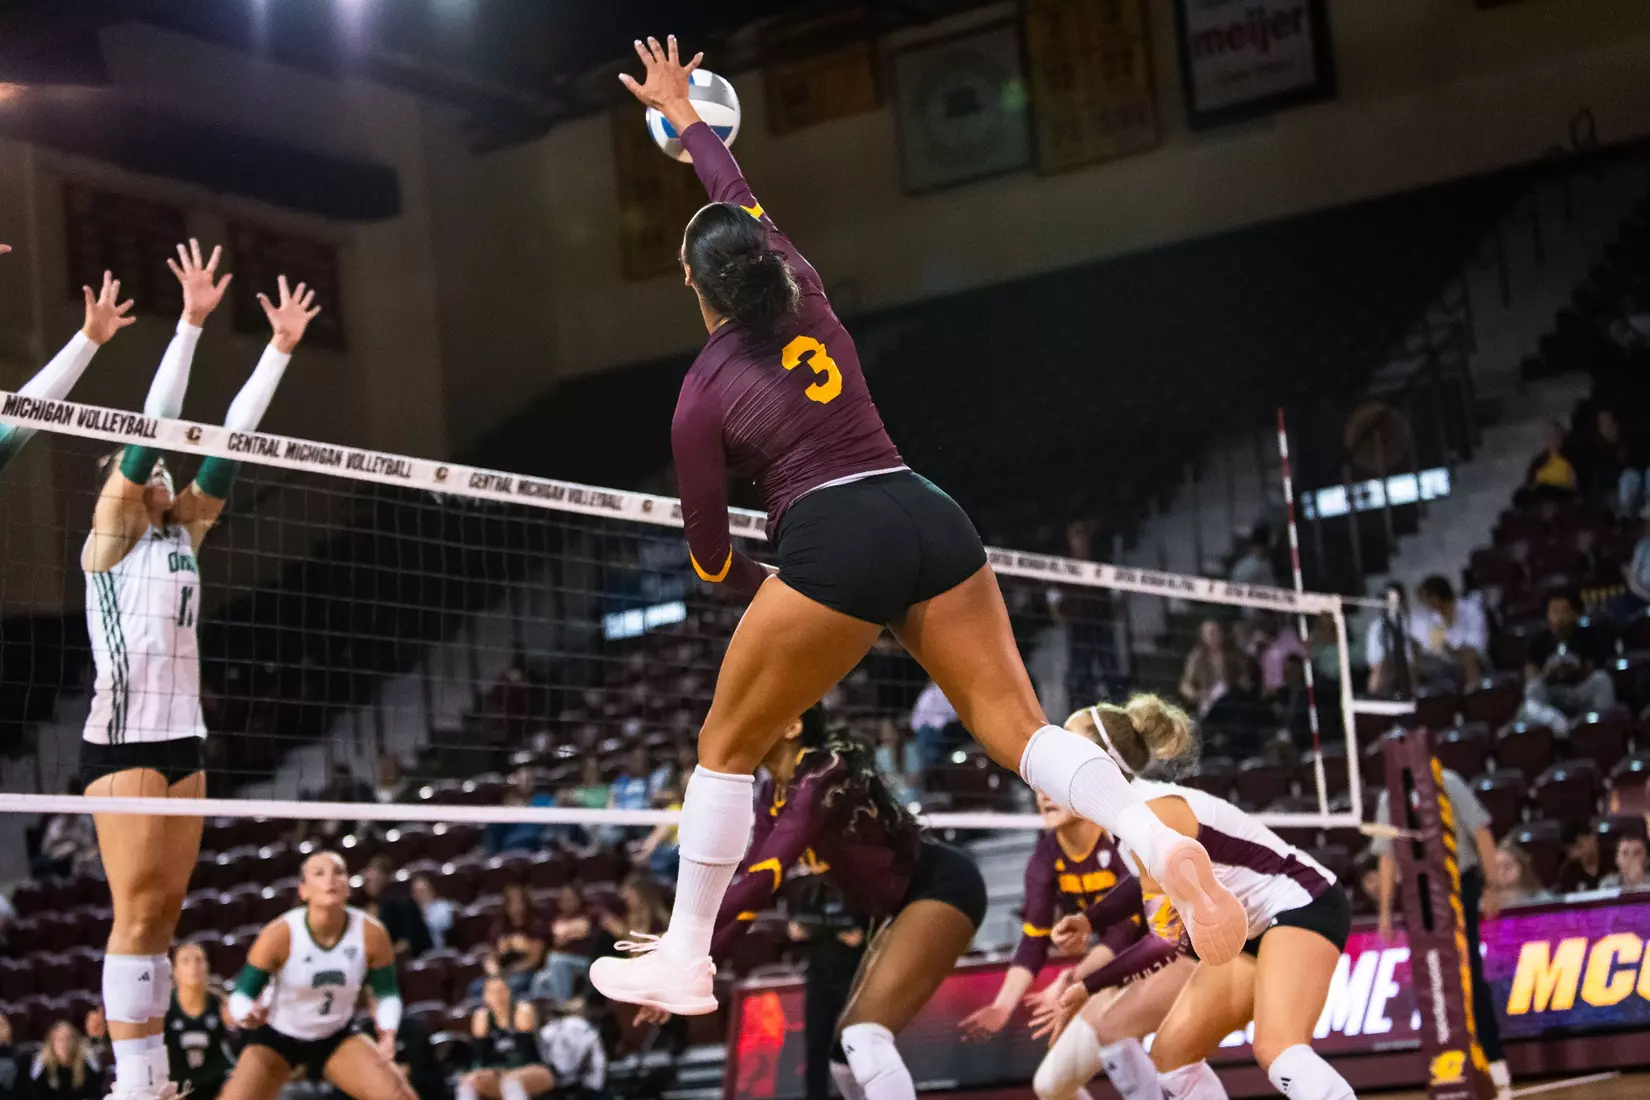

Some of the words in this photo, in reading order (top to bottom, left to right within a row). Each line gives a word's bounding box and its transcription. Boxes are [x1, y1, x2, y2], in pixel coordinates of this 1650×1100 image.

[1188, 5, 1302, 57] meijer
[781, 335, 843, 405] 3
[1, 395, 75, 425] MICHIGAN
[77, 406, 159, 439] VOLLEYBALL
[227, 432, 281, 458] CENTRAL
[283, 440, 344, 467] MICHIGAN
[346, 450, 413, 479] VOLLEYBALL
[468, 472, 514, 494] CENTRAL
